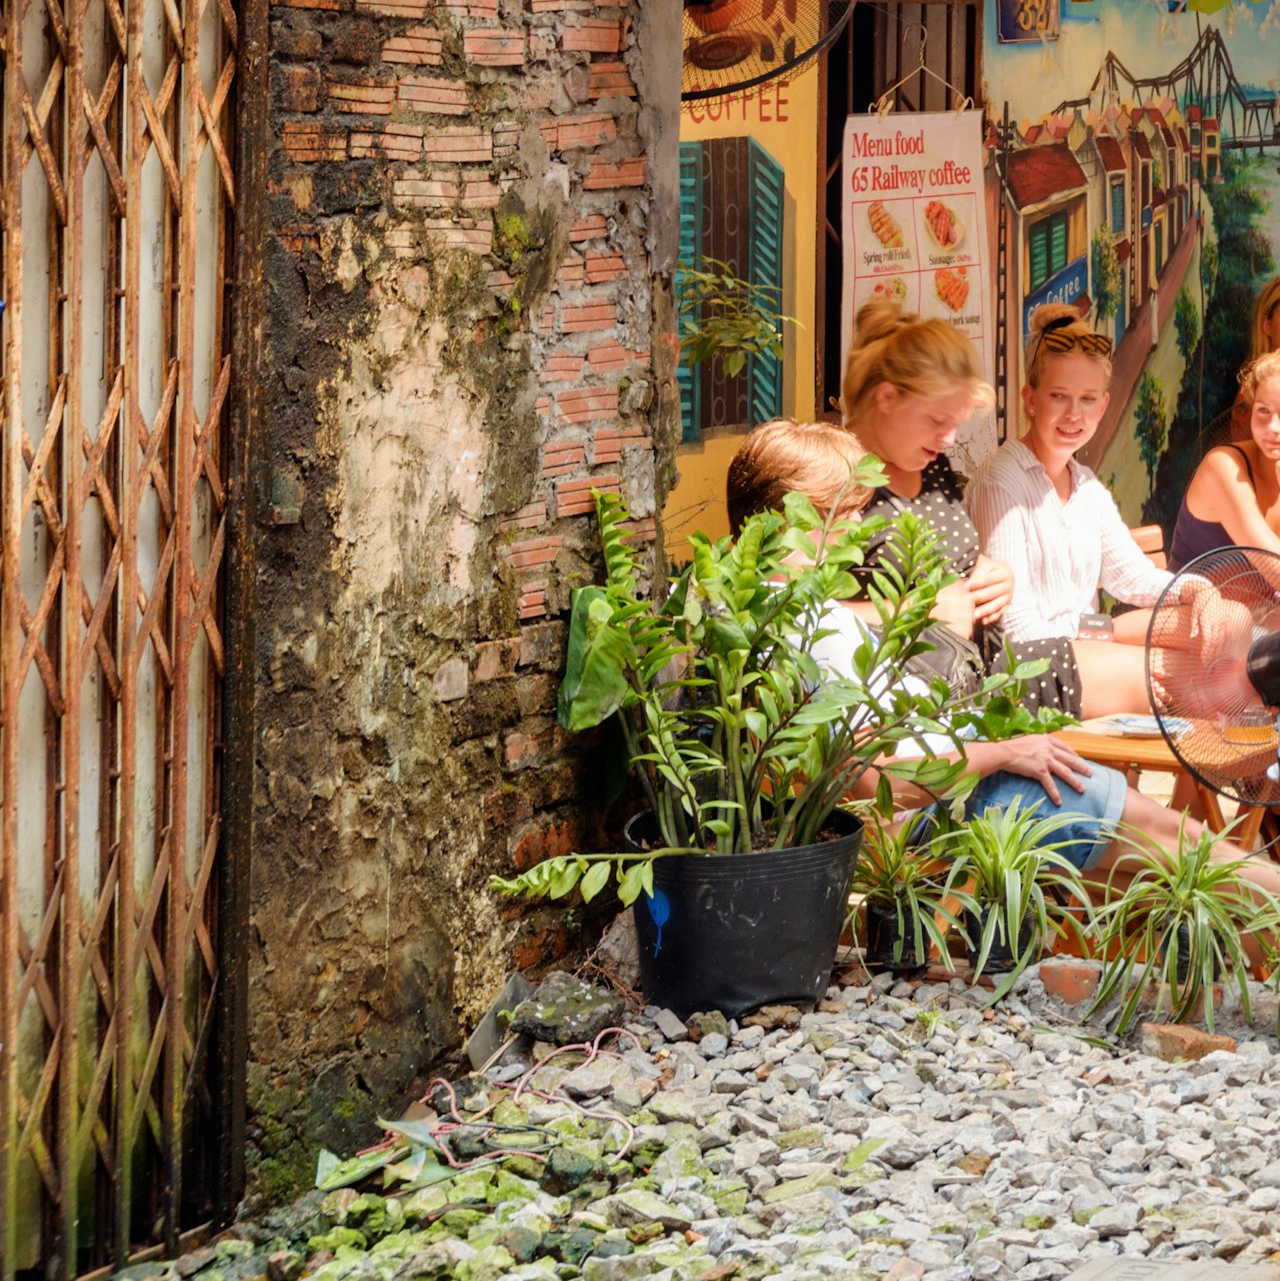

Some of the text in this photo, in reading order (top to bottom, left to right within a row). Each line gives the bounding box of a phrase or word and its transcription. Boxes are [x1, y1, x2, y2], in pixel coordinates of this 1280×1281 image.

[688, 81, 790, 124] COFFEE
[852, 130, 925, 158] Menu food
[852, 161, 971, 194] 65 Railway coffee
